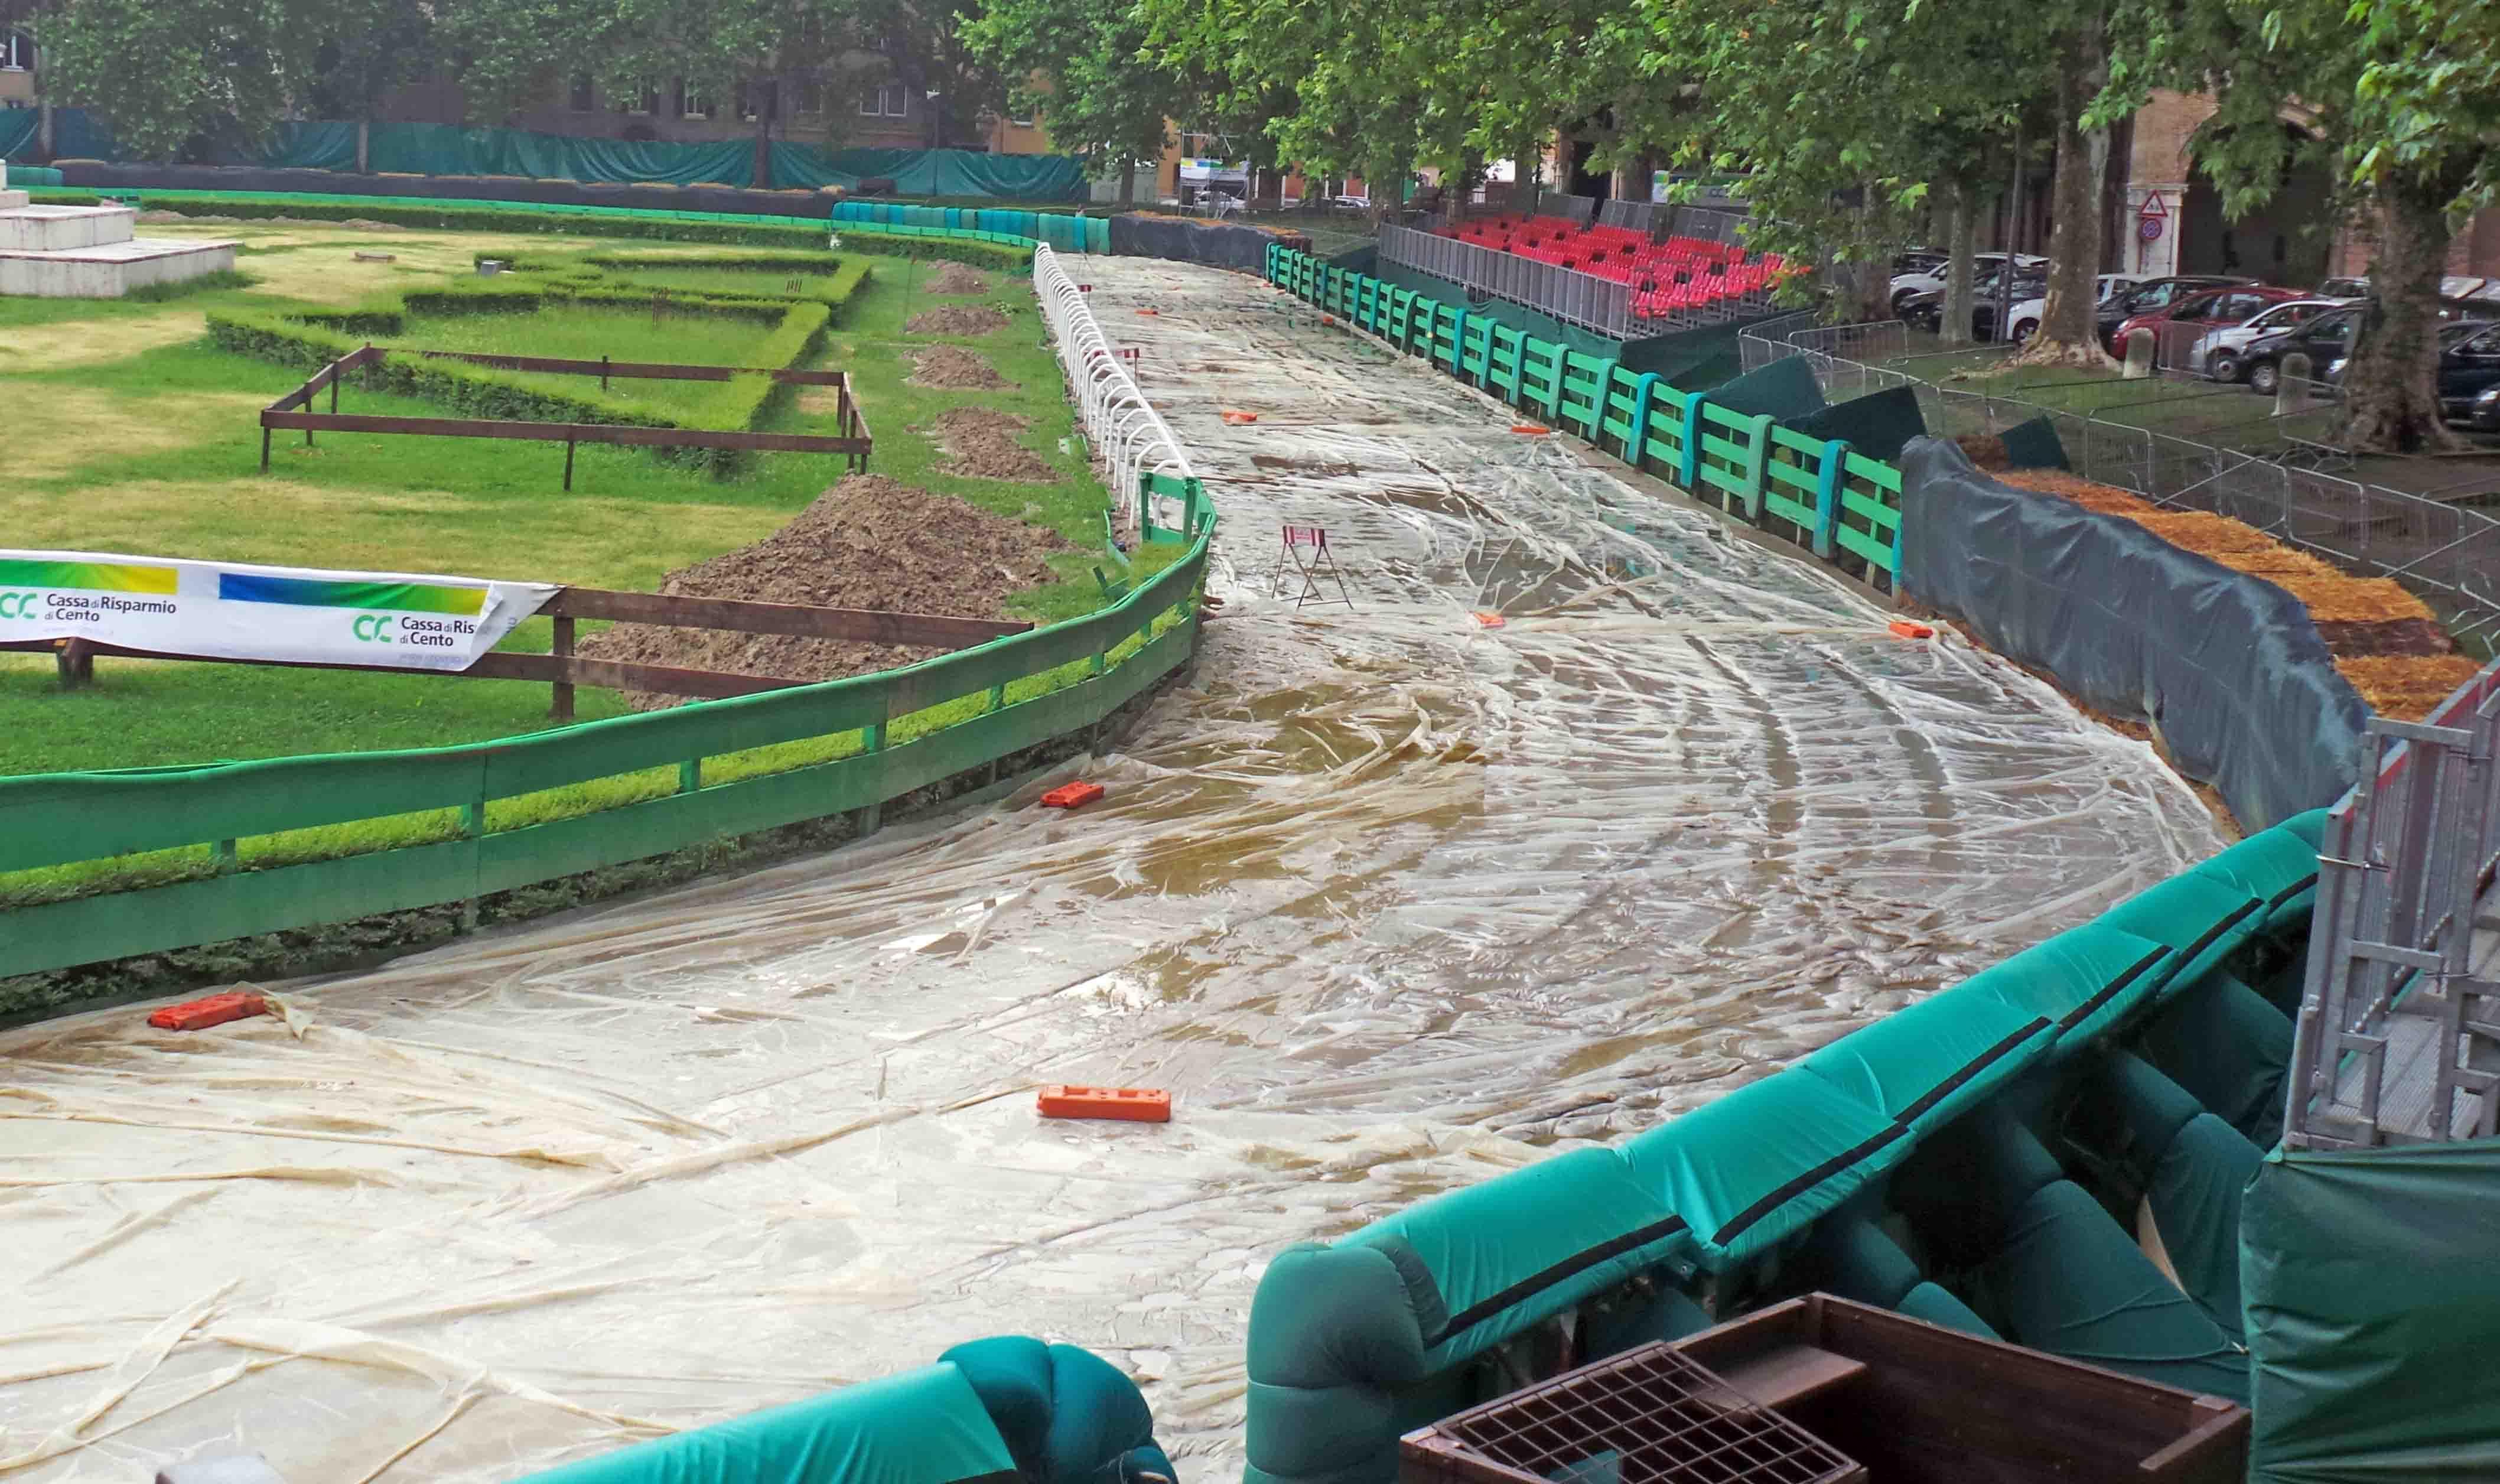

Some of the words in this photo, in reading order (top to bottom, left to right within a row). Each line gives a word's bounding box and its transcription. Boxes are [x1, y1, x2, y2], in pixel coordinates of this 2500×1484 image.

[47, 593, 89, 608] Cassa
[90, 600, 99, 608] di
[101, 595, 177, 614] Risparmio
[44, 612, 54, 620] di
[56, 608, 100, 621] Cento
[401, 616, 442, 632] Cassa
[444, 624, 453, 632] di
[454, 620, 475, 634] Ris
[400, 635, 409, 645] di
[411, 633, 454, 647] Cento
